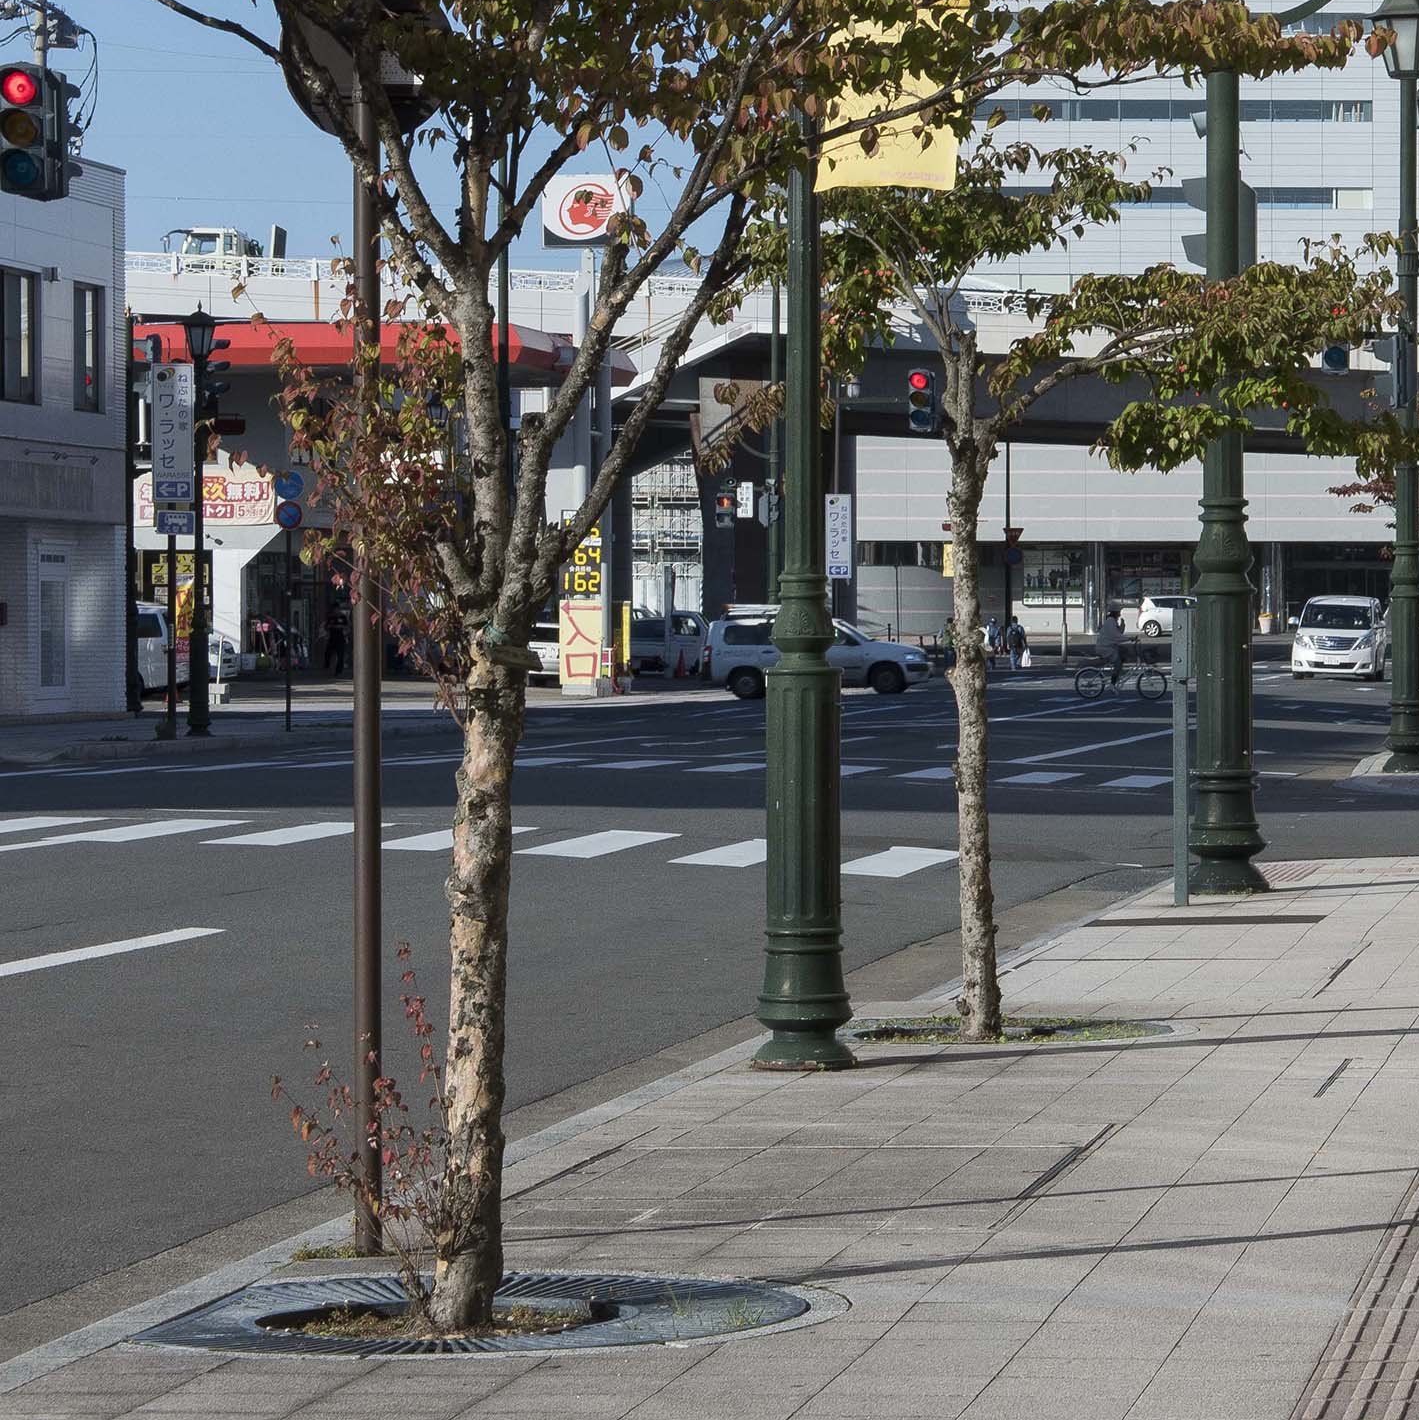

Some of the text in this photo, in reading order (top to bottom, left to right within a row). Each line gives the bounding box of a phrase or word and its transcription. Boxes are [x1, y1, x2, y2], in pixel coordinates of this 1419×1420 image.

[159, 394, 175, 469] ワ・ラッセ
[177, 484, 188, 496] P
[567, 546, 600, 565] 64
[564, 572, 600, 592] 162
[566, 614, 598, 677] 入口
